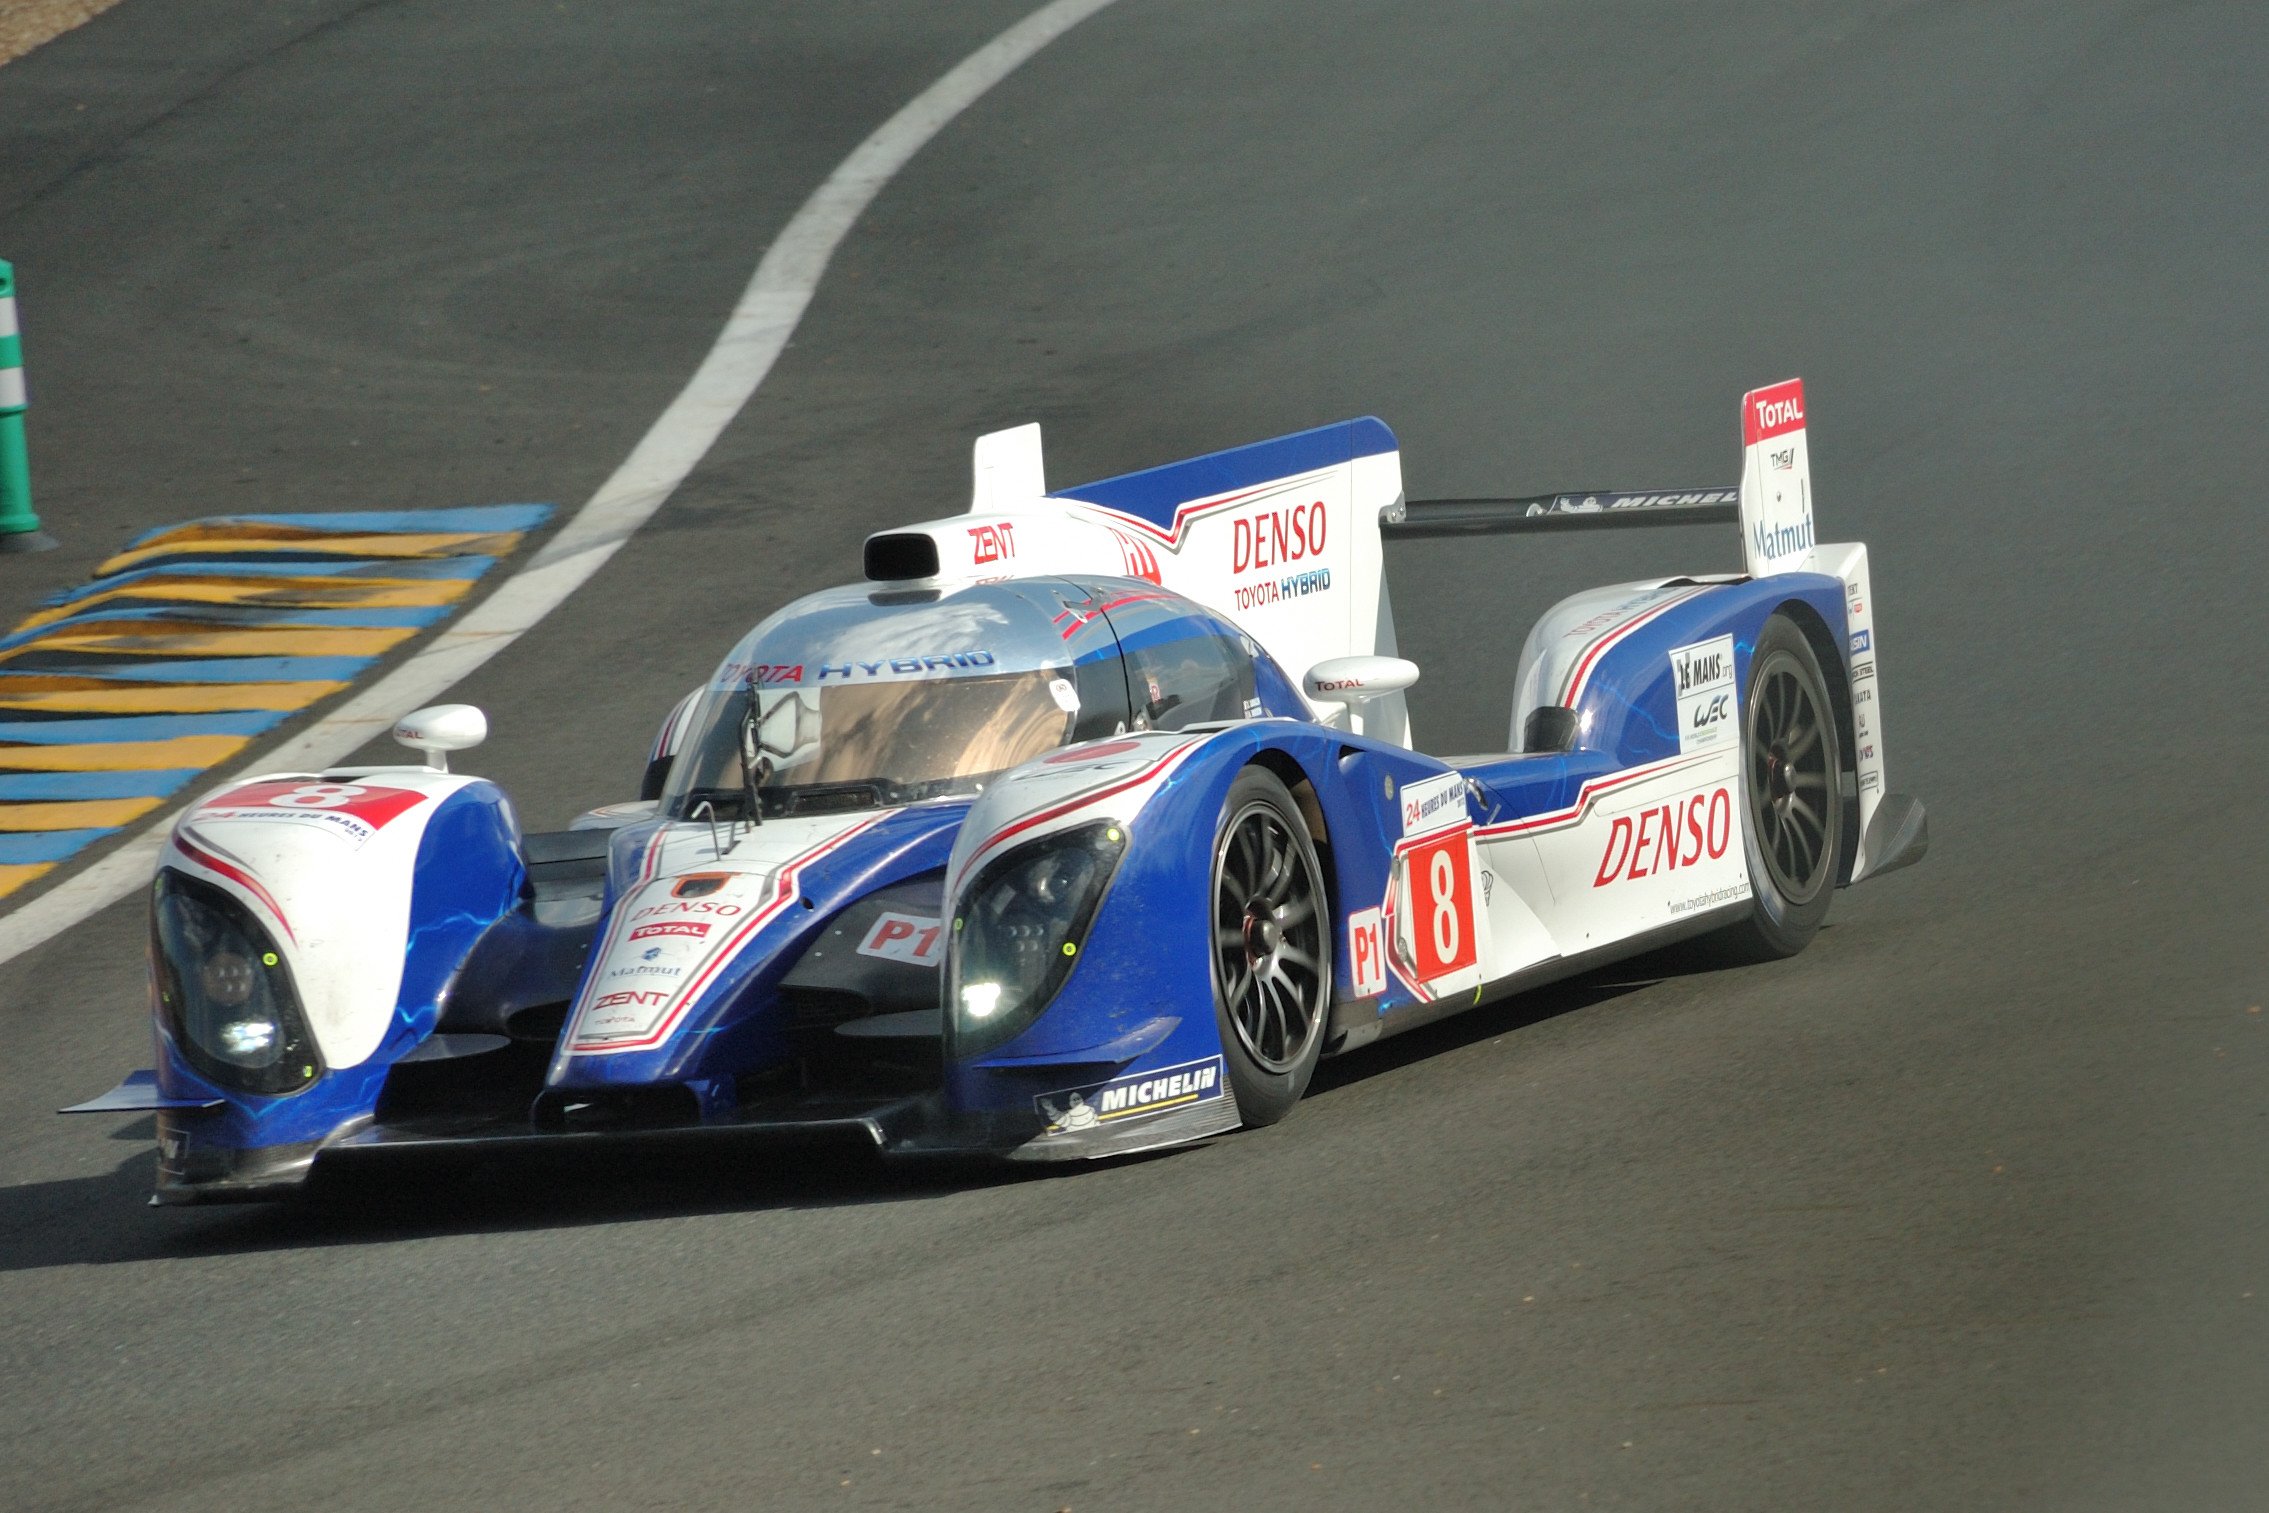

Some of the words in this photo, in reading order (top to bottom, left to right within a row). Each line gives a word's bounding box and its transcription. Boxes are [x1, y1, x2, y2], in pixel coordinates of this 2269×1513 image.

[1756, 398, 1803, 429] TOTAL
[1611, 492, 1737, 508] MICHEL
[968, 522, 1015, 564] ZENT
[1234, 501, 1327, 574] DENSO
[1753, 514, 1814, 559] Matmut
[1235, 581, 1279, 611] TOYOTA
[1281, 568, 1331, 600] HYBRID
[818, 650, 996, 681] HYBRID
[1694, 653, 1720, 686] MANS
[1315, 679, 1364, 692] TOTAL
[1694, 694, 1729, 728] WEC
[269, 784, 367, 808] 8
[325, 815, 369, 837] MANS
[1406, 799, 1420, 827] 24
[1593, 787, 1730, 888] DENSO
[630, 901, 742, 922] DENSO
[1431, 850, 1460, 965] 8
[634, 924, 705, 938] TOTAL
[868, 919, 940, 957] P1
[1354, 922, 1381, 986] P1
[593, 991, 669, 1011] ZENT
[1101, 1066, 1217, 1112] MICHELIN
